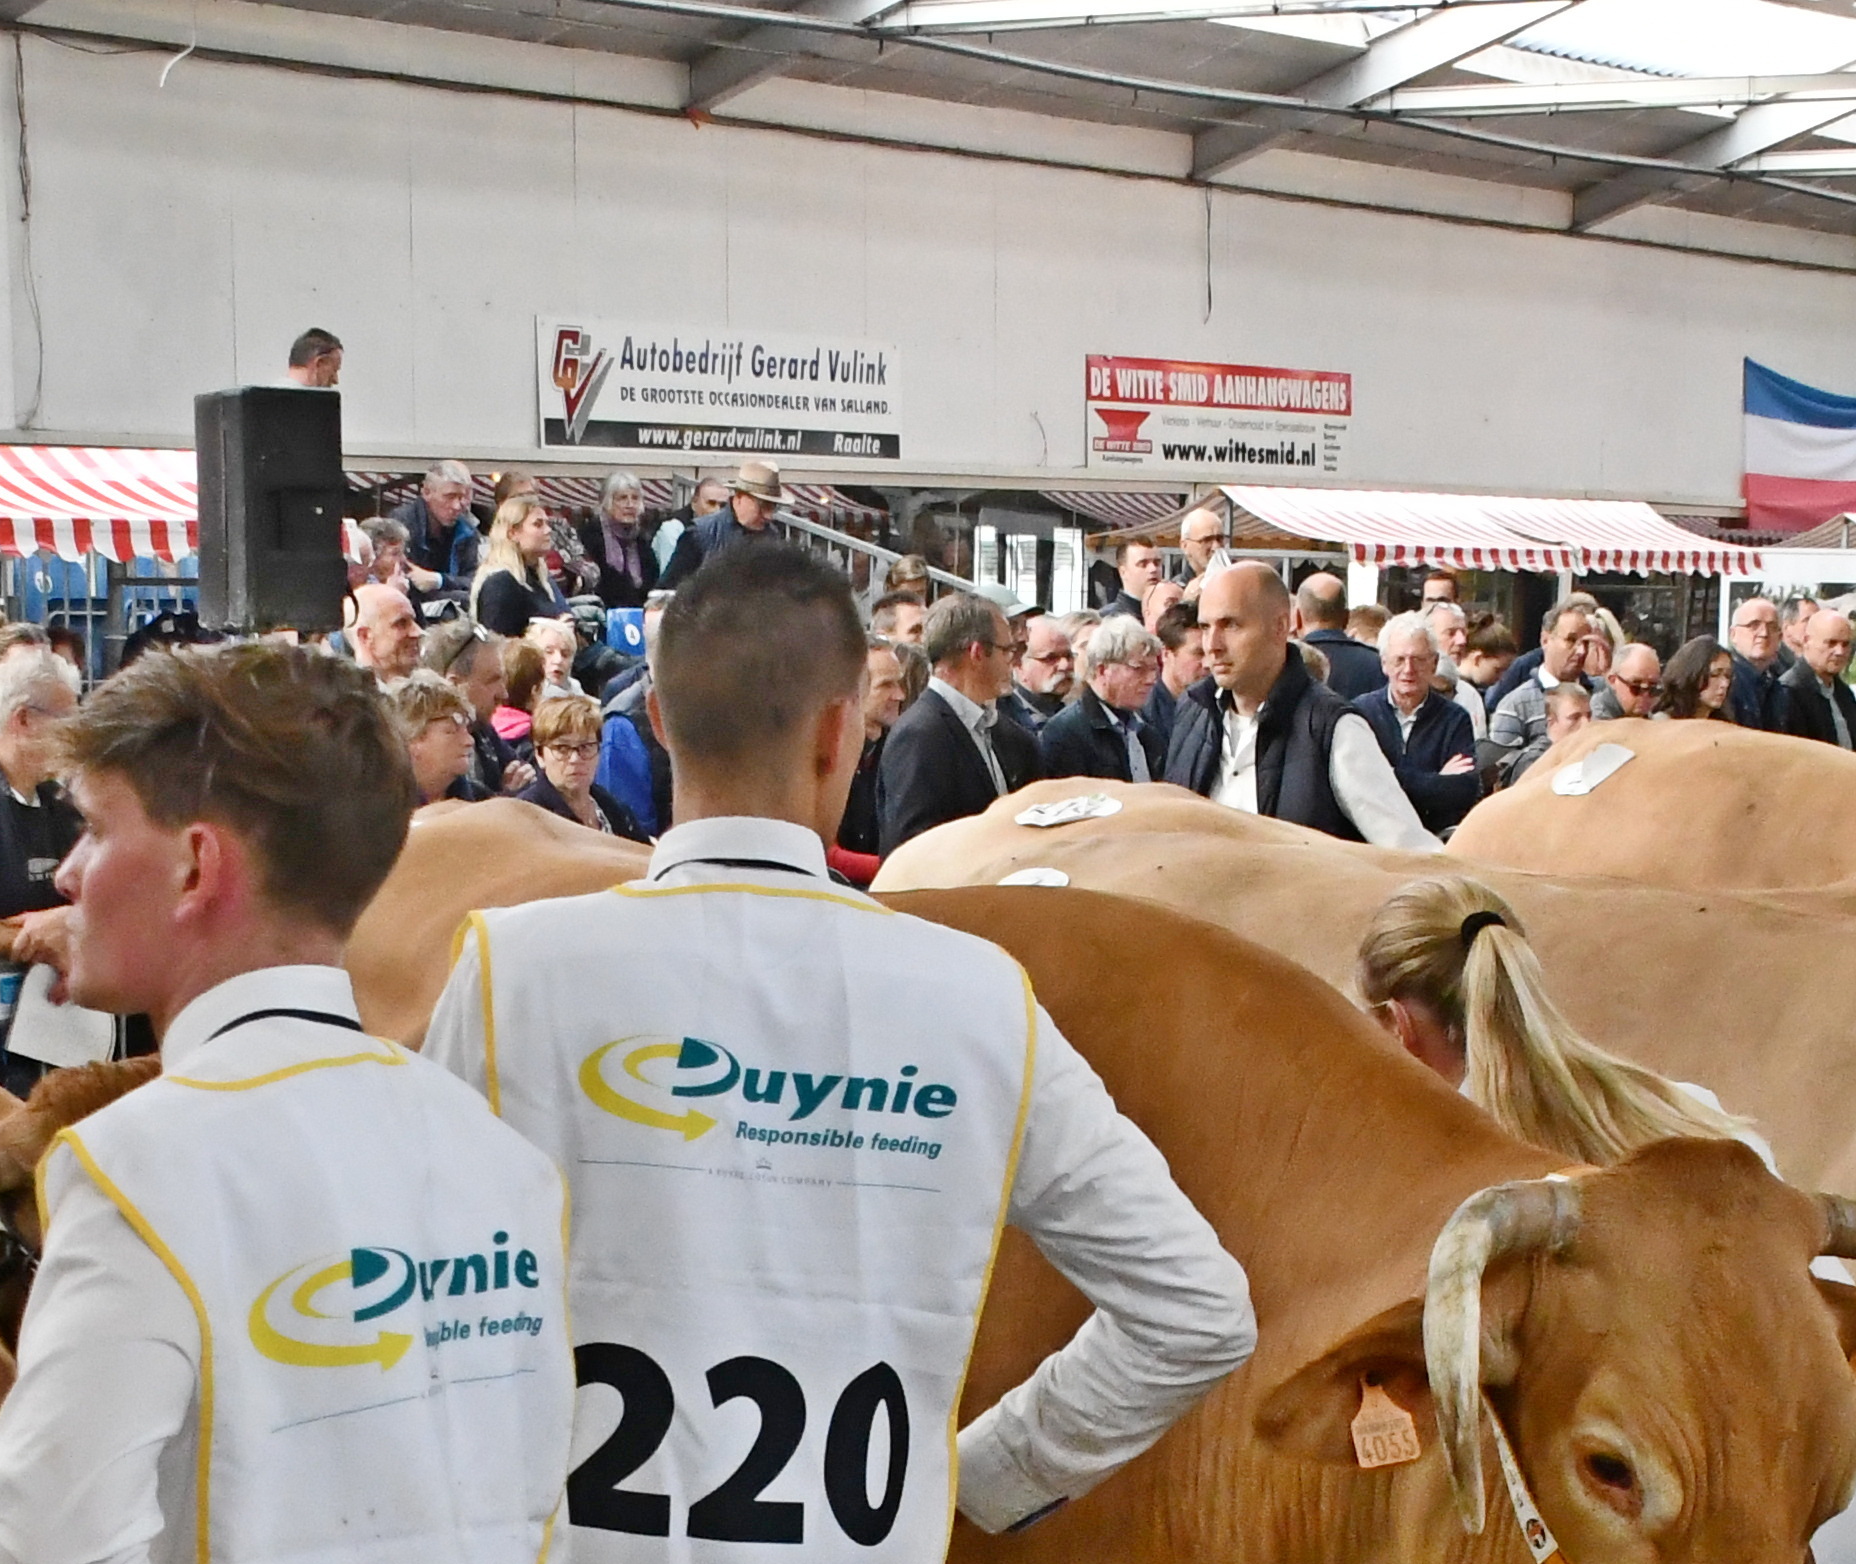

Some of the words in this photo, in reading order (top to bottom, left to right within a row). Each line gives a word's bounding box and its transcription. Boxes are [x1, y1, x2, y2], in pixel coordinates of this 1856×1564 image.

[620, 335, 744, 385] Autobedrijf
[750, 344, 821, 383] Gerard
[827, 343, 888, 386] Vulink
[620, 386, 636, 401] DE
[641, 387, 705, 406] GROOTSTE
[709, 391, 810, 412] OCCASIONDEALER
[814, 397, 837, 413] VAN
[840, 398, 893, 416] SALLAND.
[1090, 366, 1111, 398] DE
[1116, 368, 1164, 401] WITTE
[1169, 371, 1209, 404] SMID
[1213, 373, 1348, 412] AANHANGWAGENS
[638, 426, 802, 452] www.gerardvulink.nl
[833, 433, 881, 455] Raalte
[1161, 438, 1316, 467] www.wittesmid.nl
[671, 1036, 959, 1122] Duynie
[736, 1119, 865, 1151] Responsible
[870, 1130, 943, 1160] feeding
[566, 1341, 910, 1548] 220
